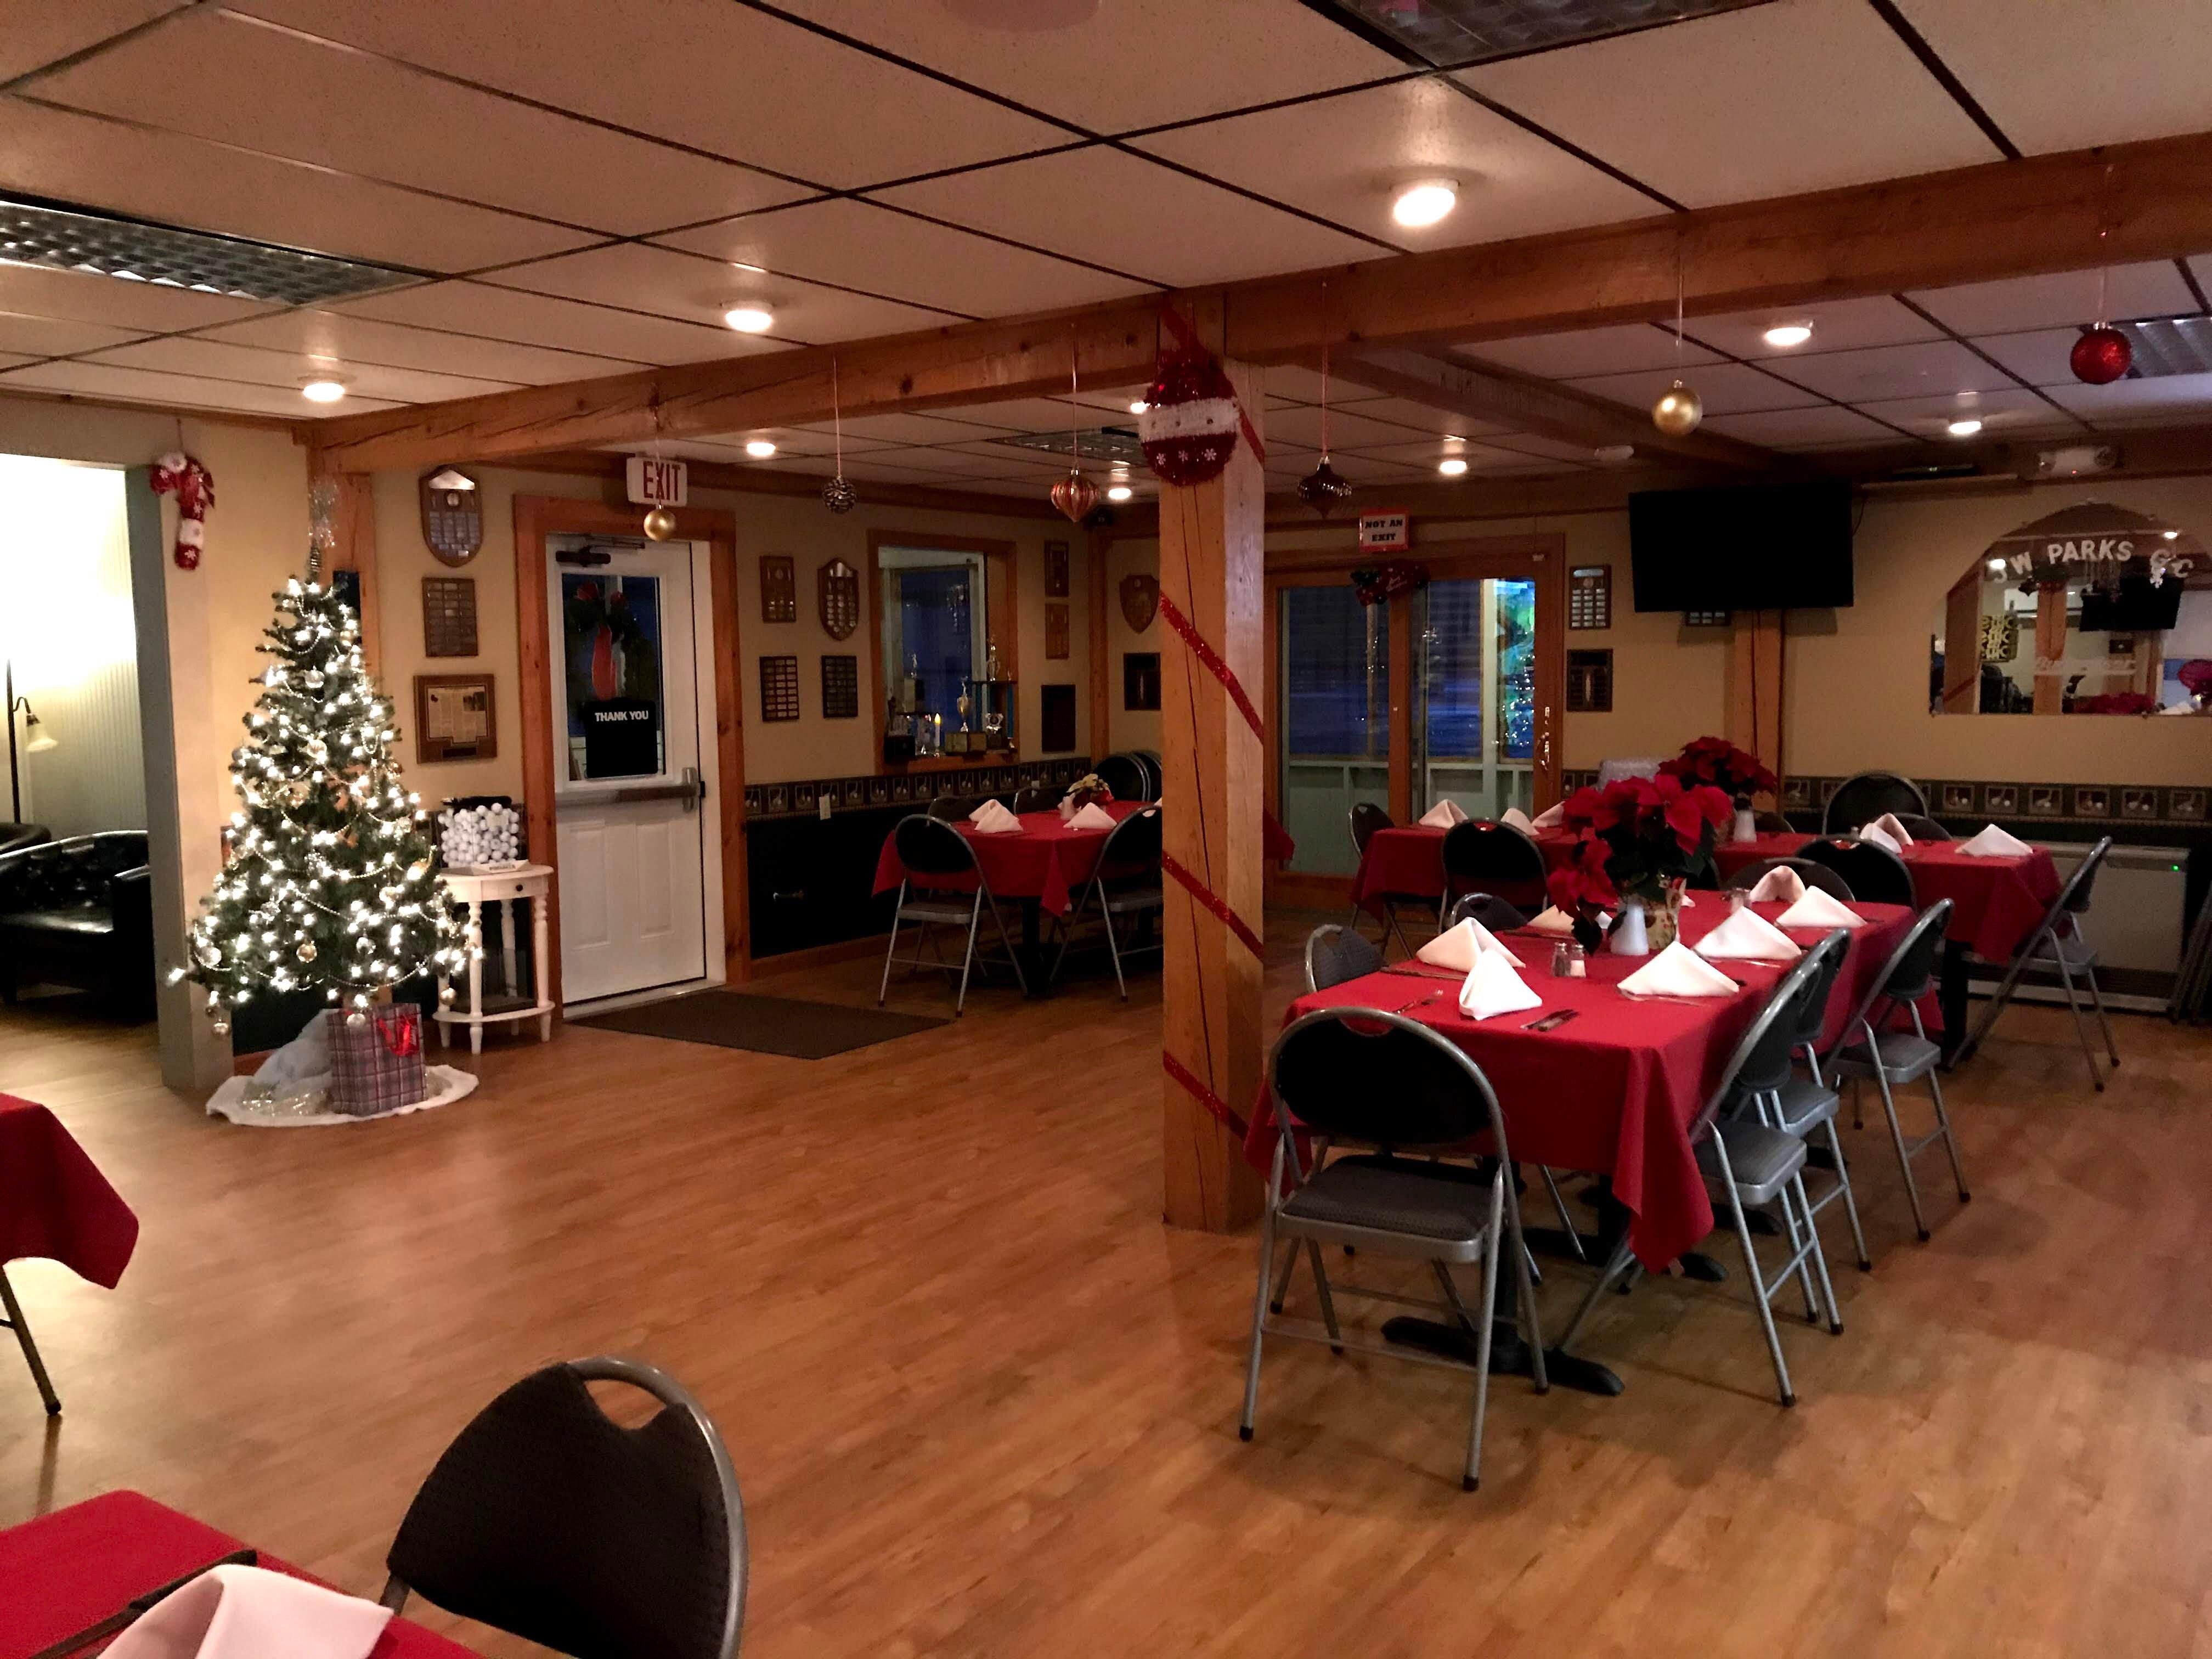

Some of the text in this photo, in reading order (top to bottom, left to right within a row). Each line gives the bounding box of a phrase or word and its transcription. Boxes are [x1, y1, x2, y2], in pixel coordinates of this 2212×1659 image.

[643, 461, 681, 501] EXIT
[1365, 519, 1403, 528] NOT AN
[1372, 533, 1396, 541] EXIT
[2047, 539, 2134, 565] PARKS
[595, 710, 648, 722] THANK YOU
